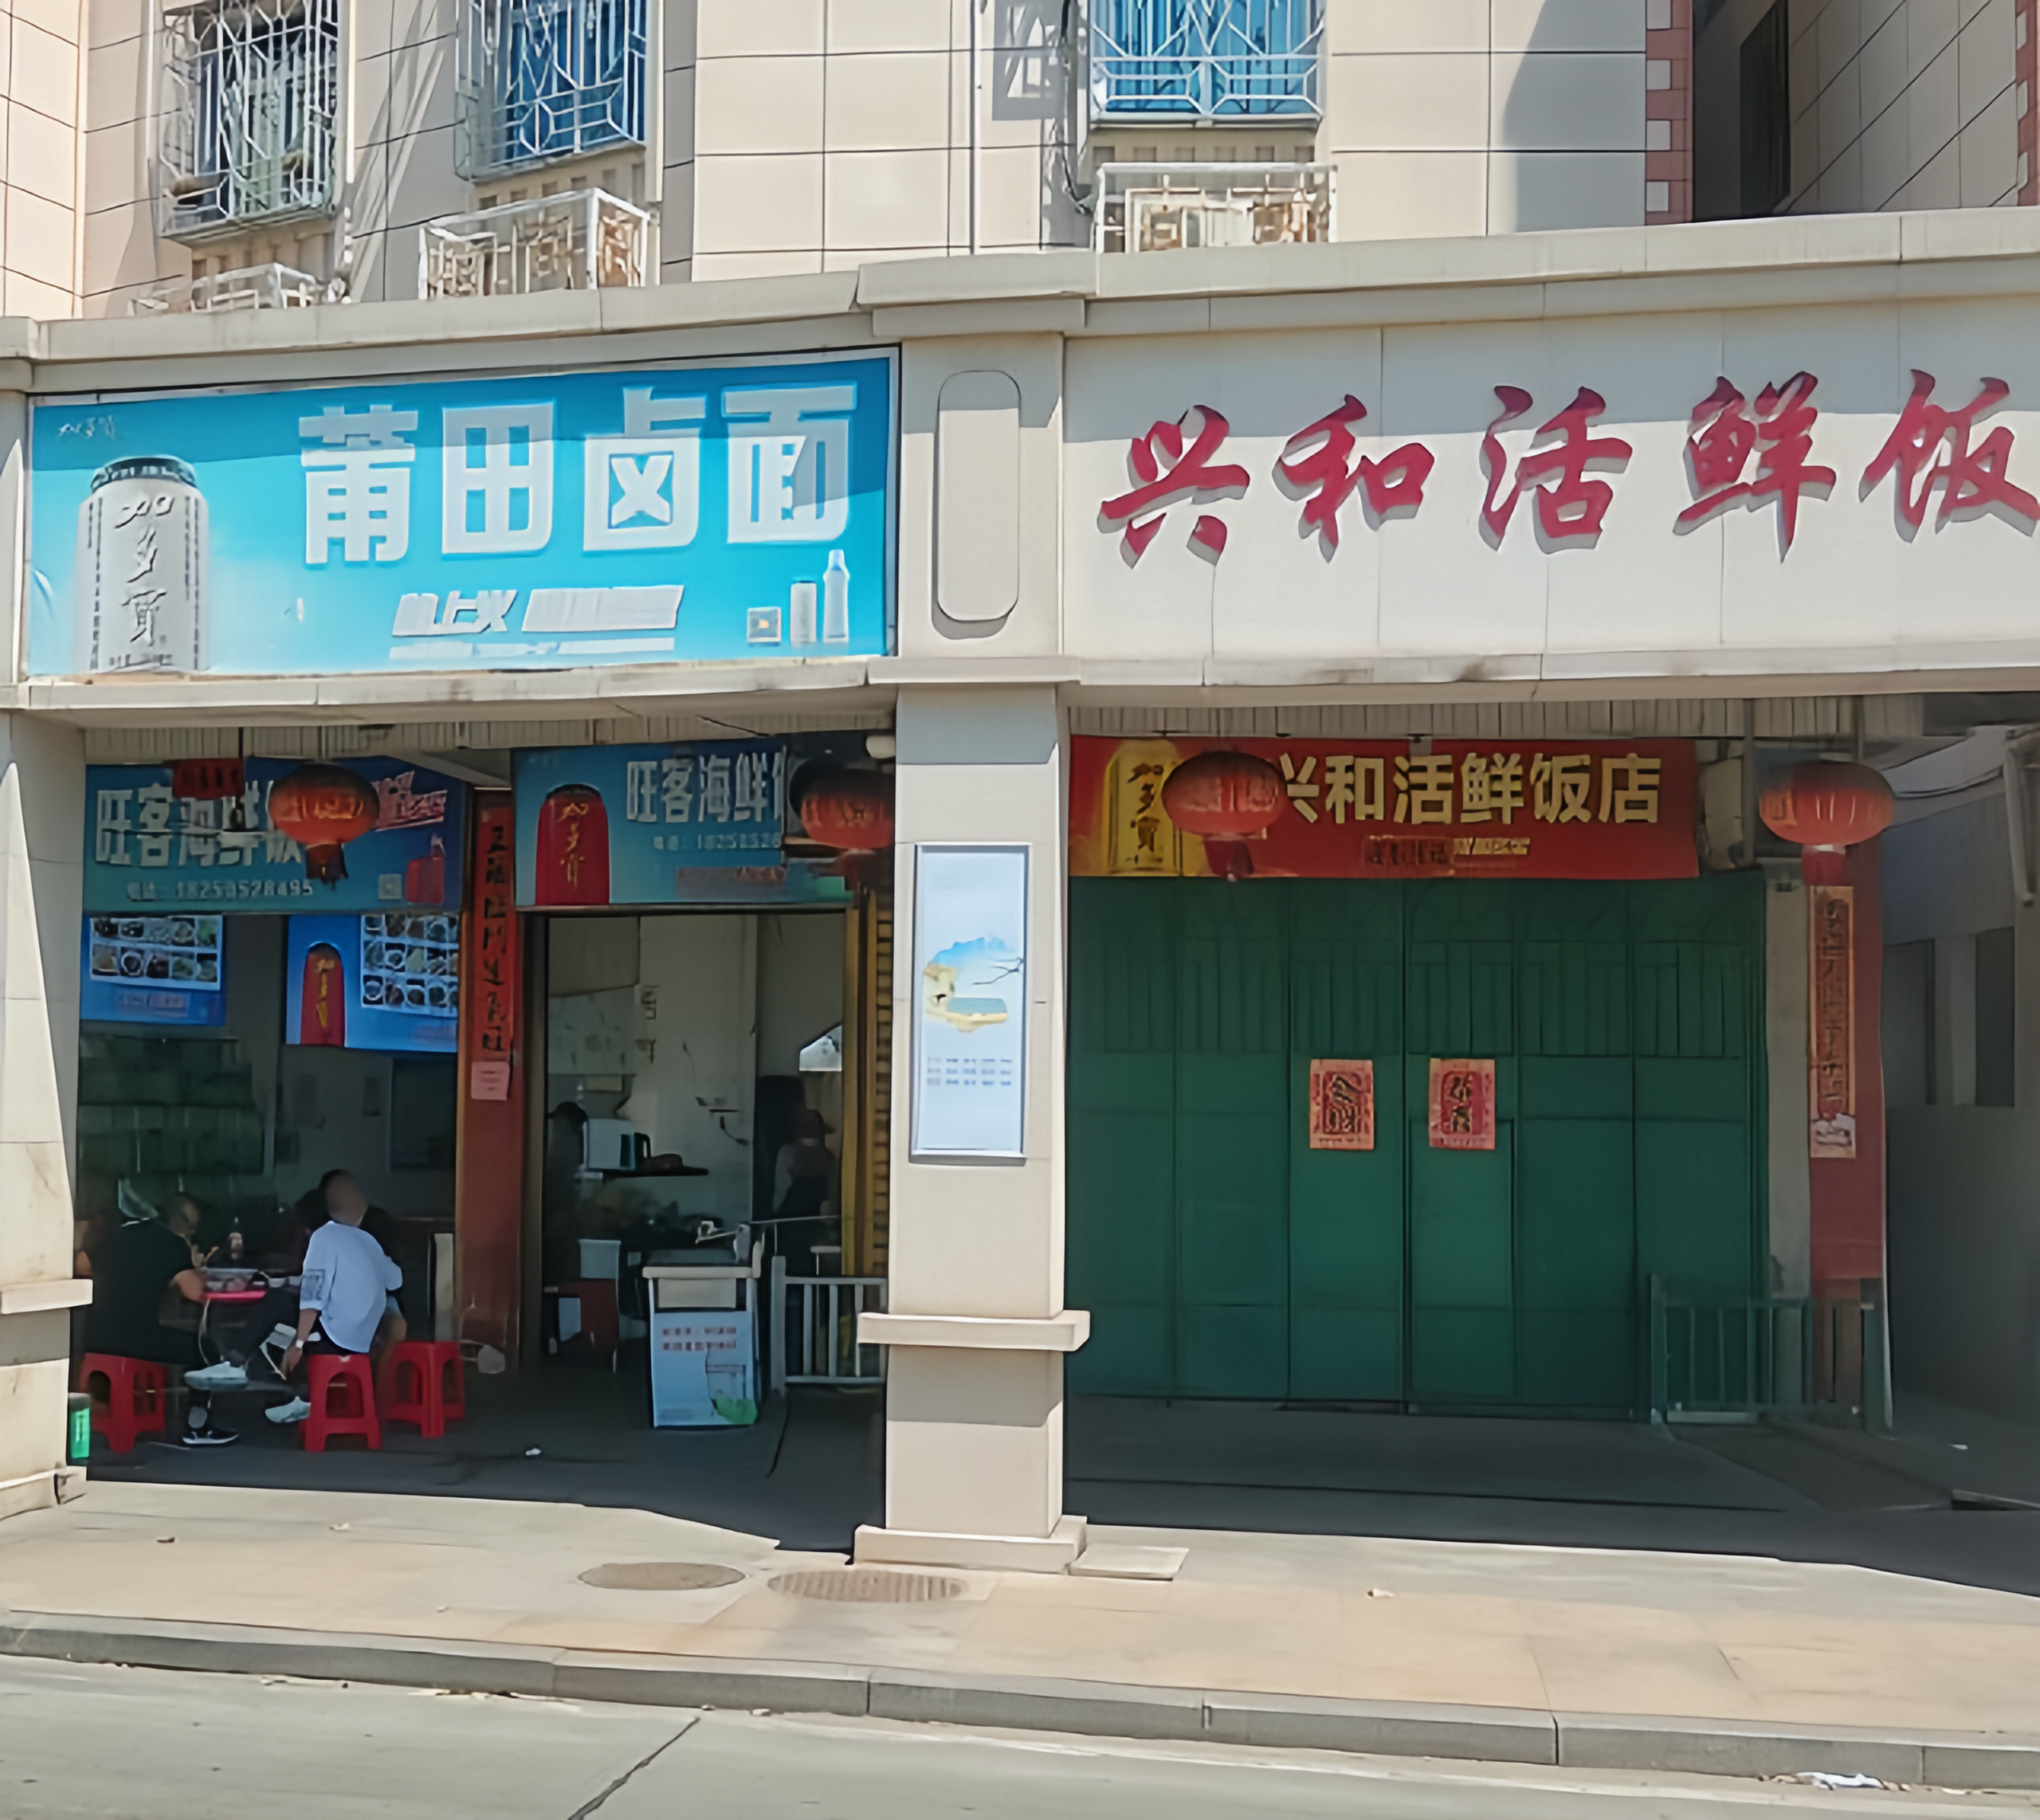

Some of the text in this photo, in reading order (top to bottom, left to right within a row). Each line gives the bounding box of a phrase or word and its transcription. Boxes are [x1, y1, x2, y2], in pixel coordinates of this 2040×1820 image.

[299, 381, 857, 564] 莆田卤面
[1097, 370, 2040, 568] 兴和活鲜饭
[626, 751, 784, 823] 旺客海鲜
[1280, 752, 1661, 823] 兴和活鲜饭店
